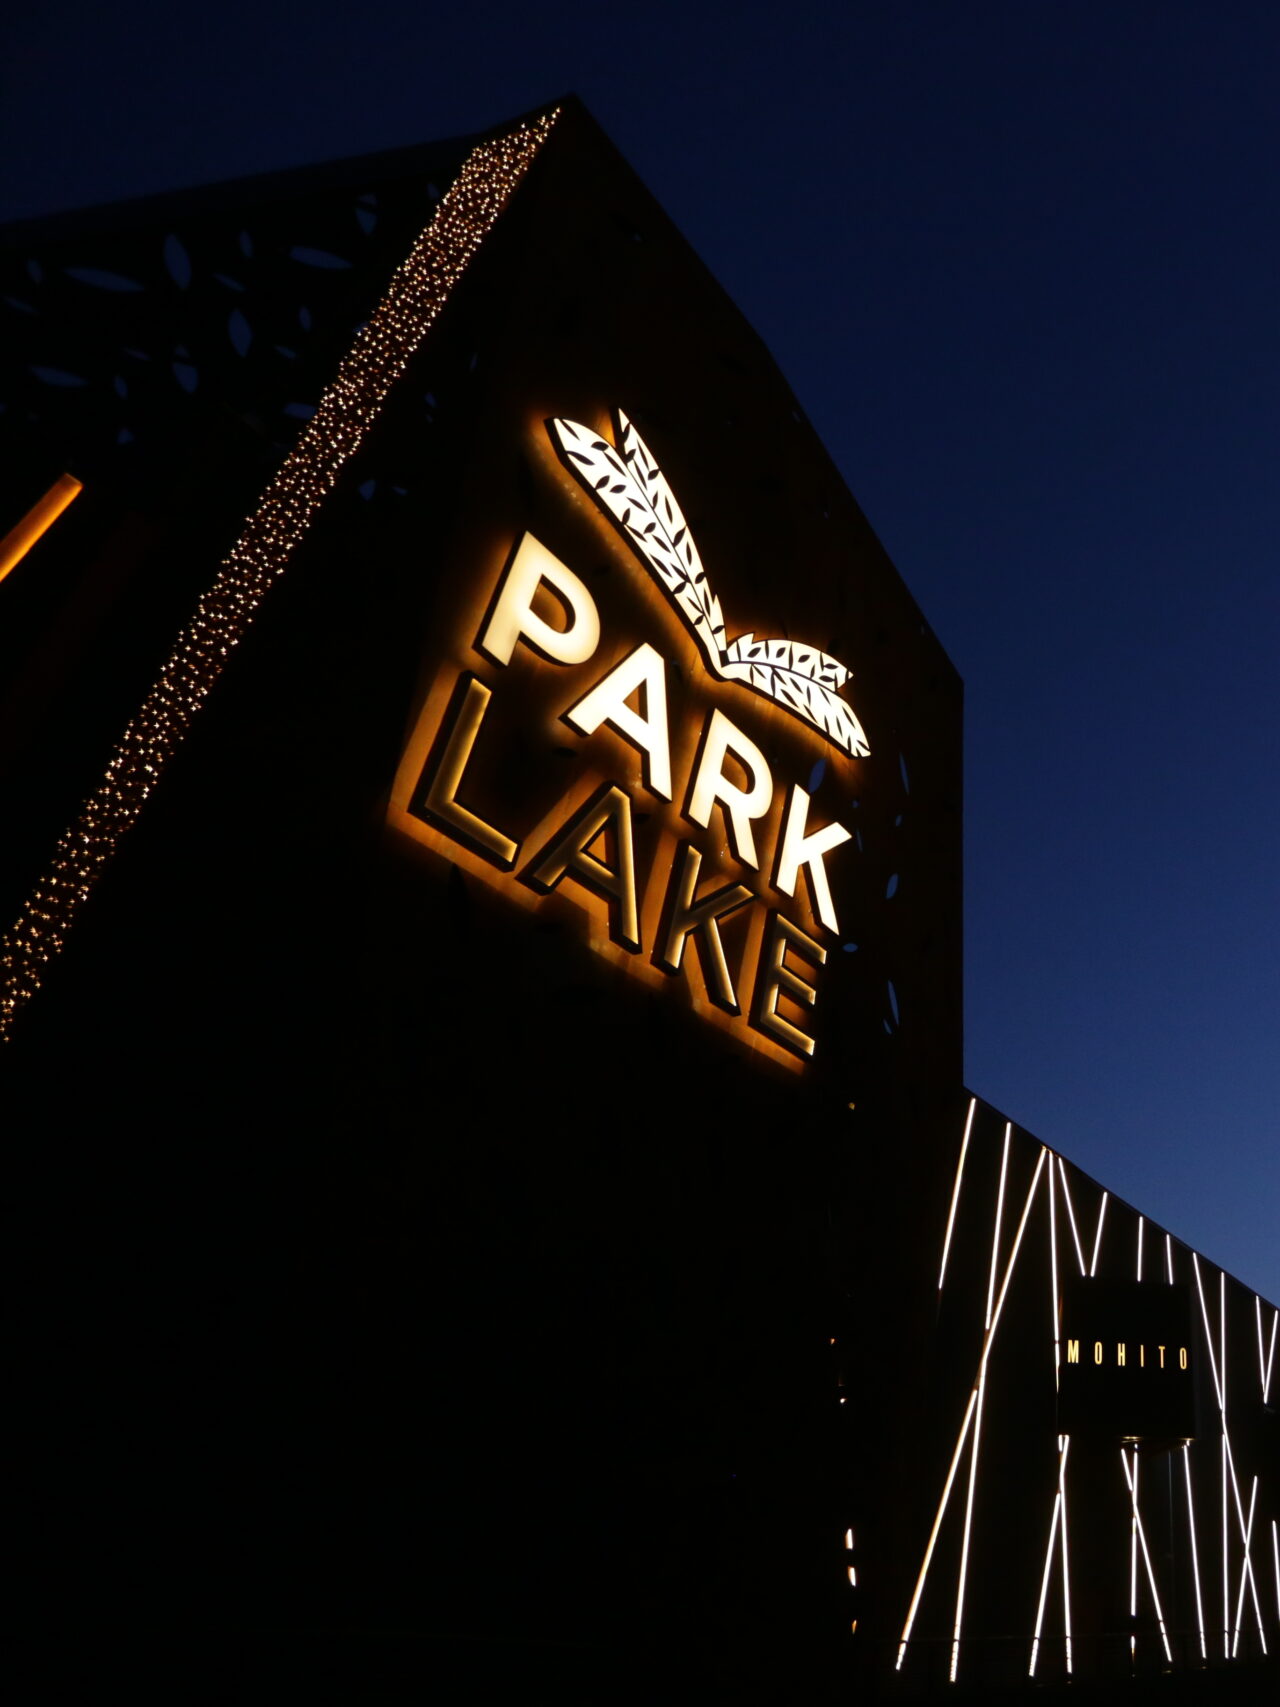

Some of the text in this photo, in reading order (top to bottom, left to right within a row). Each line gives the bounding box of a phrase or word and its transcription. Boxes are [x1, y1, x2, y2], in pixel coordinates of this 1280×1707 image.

[409, 671, 828, 1058] LAKE
[478, 530, 853, 936] PARK
[1067, 1339, 1187, 1370] MOHITO
